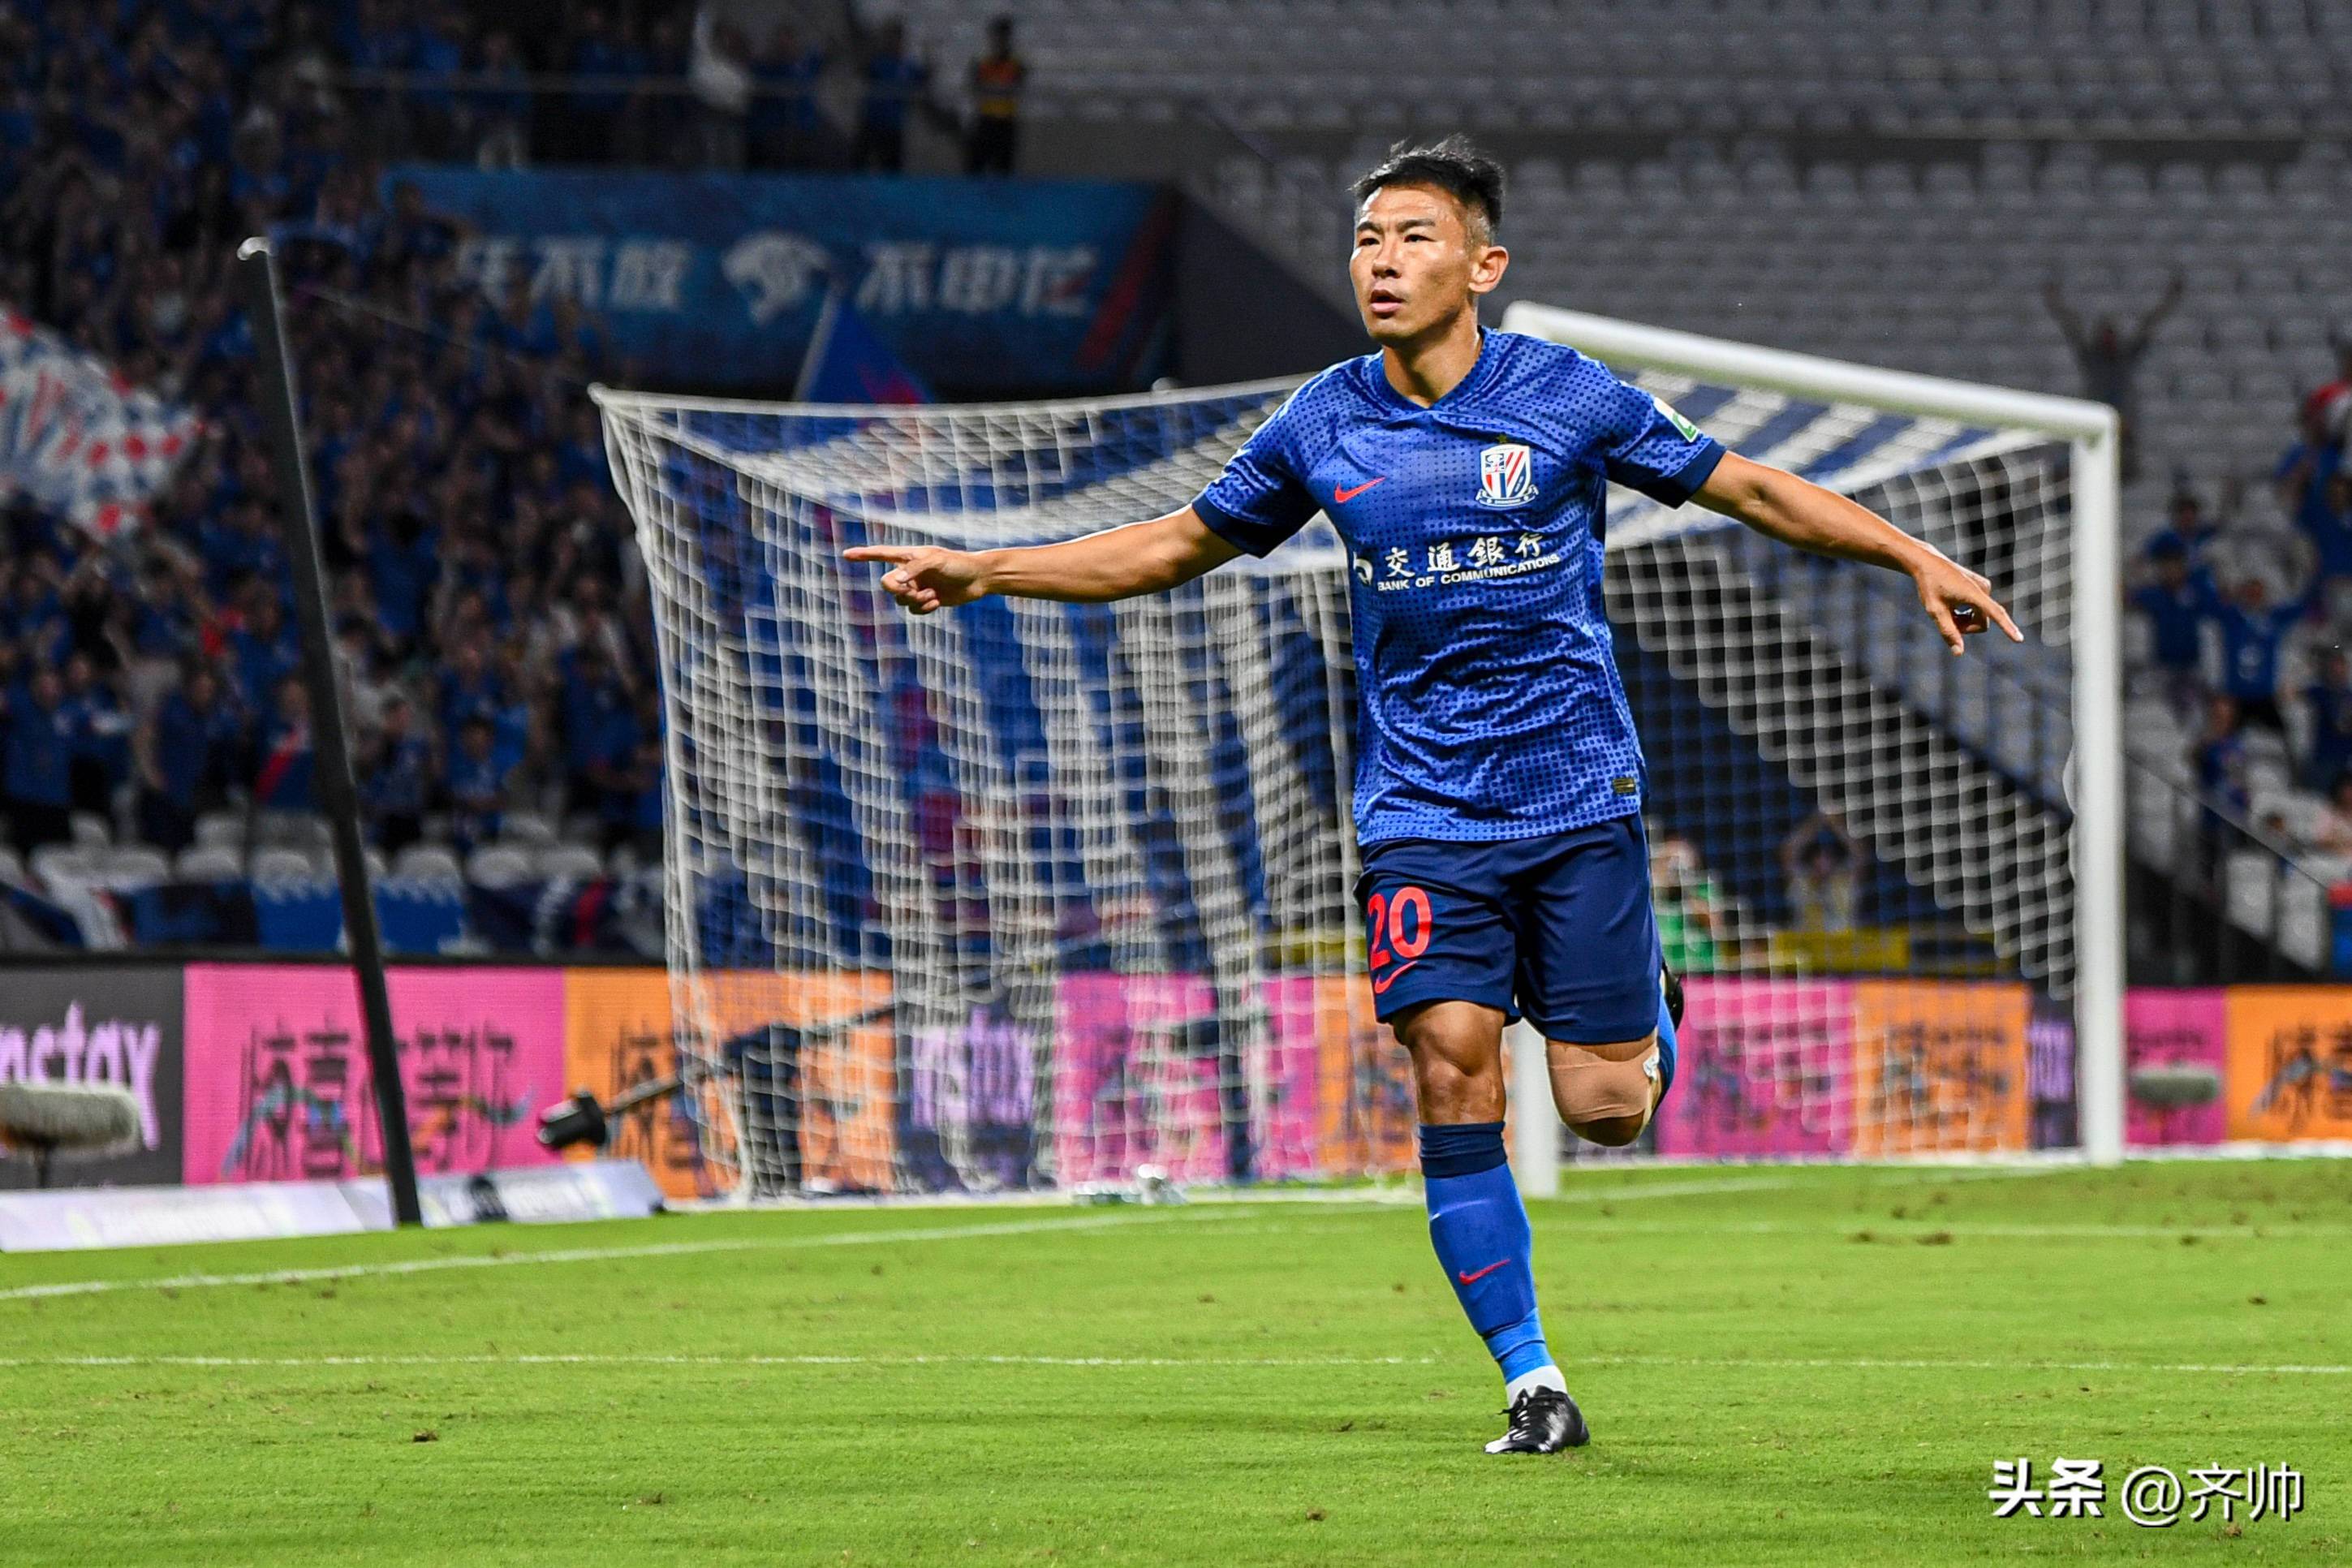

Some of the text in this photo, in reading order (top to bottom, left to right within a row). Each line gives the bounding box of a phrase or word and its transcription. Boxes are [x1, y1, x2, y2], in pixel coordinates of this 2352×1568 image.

[1377, 553, 1561, 592] BANK OF COMMUNICATIONS
[1385, 532, 1543, 578] 交通銀行
[1368, 885, 1432, 971] 20
